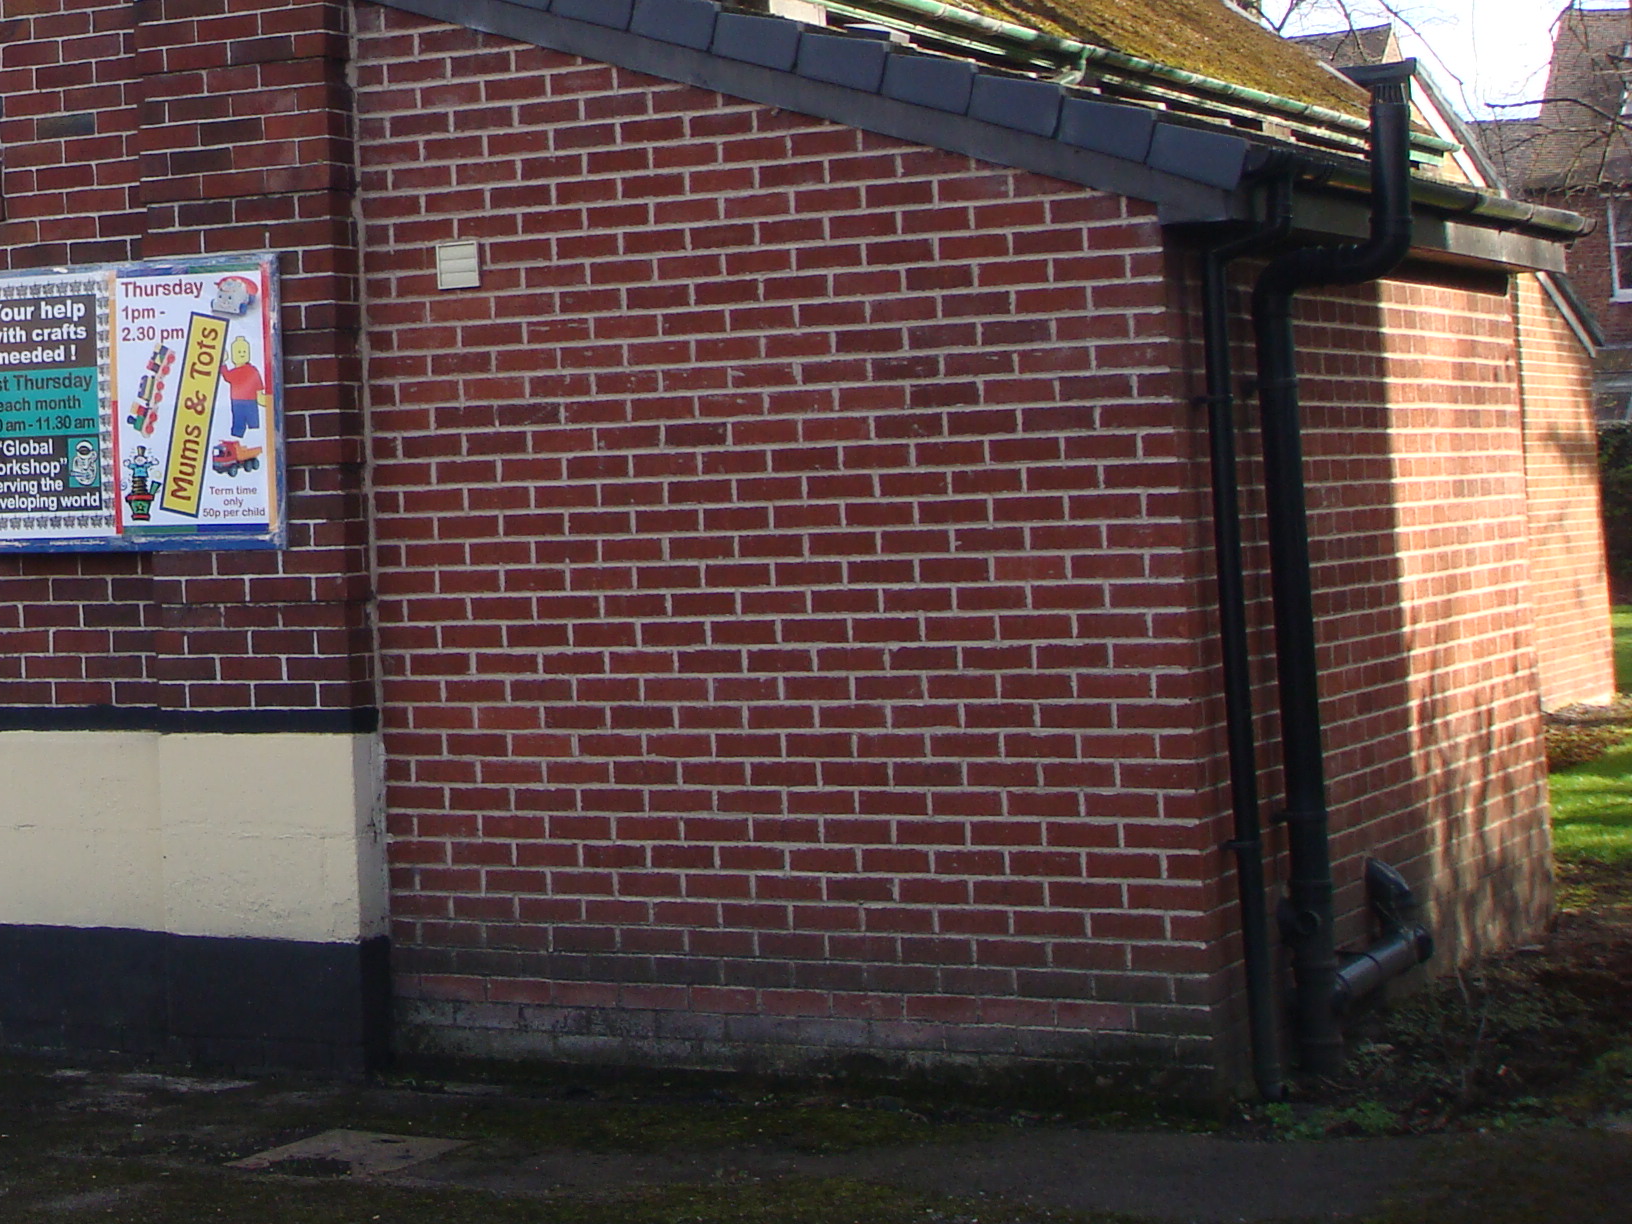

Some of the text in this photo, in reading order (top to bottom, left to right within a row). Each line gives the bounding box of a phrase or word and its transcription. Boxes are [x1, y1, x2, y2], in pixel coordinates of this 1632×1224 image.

[121, 279, 203, 301] Thursday
[40, 299, 86, 322] help
[121, 307, 155, 323] 1pm
[31, 323, 87, 342] crafts
[121, 326, 185, 345] 2.30 pm
[70, 345, 77, 361] !
[14, 372, 93, 392] Thursday
[35, 396, 81, 411] month
[170, 327, 219, 503] Mums & Tots
[5, 420, 26, 432] am
[35, 416, 72, 431] 11.30
[74, 418, 96, 429] am
[41, 478, 63, 492] the
[209, 485, 258, 496] Term time
[61, 492, 100, 508] world
[224, 497, 244, 508] only
[203, 507, 266, 519] 50p per child
